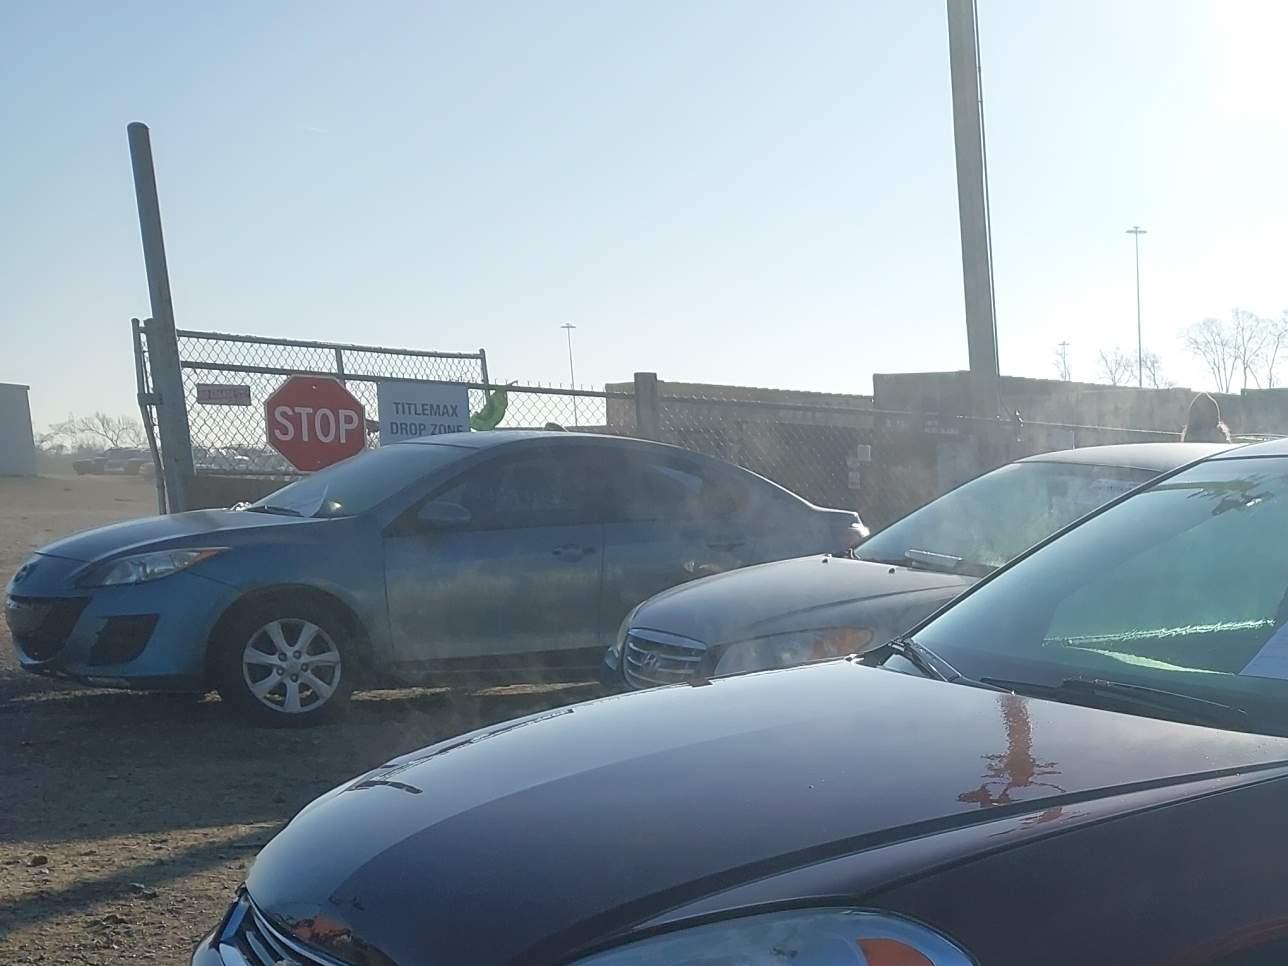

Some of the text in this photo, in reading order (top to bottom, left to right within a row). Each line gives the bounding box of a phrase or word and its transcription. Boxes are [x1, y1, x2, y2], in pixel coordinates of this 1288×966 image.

[392, 402, 458, 417] TITLEMAX
[273, 405, 359, 443] STOP
[390, 422, 426, 436] DROP
